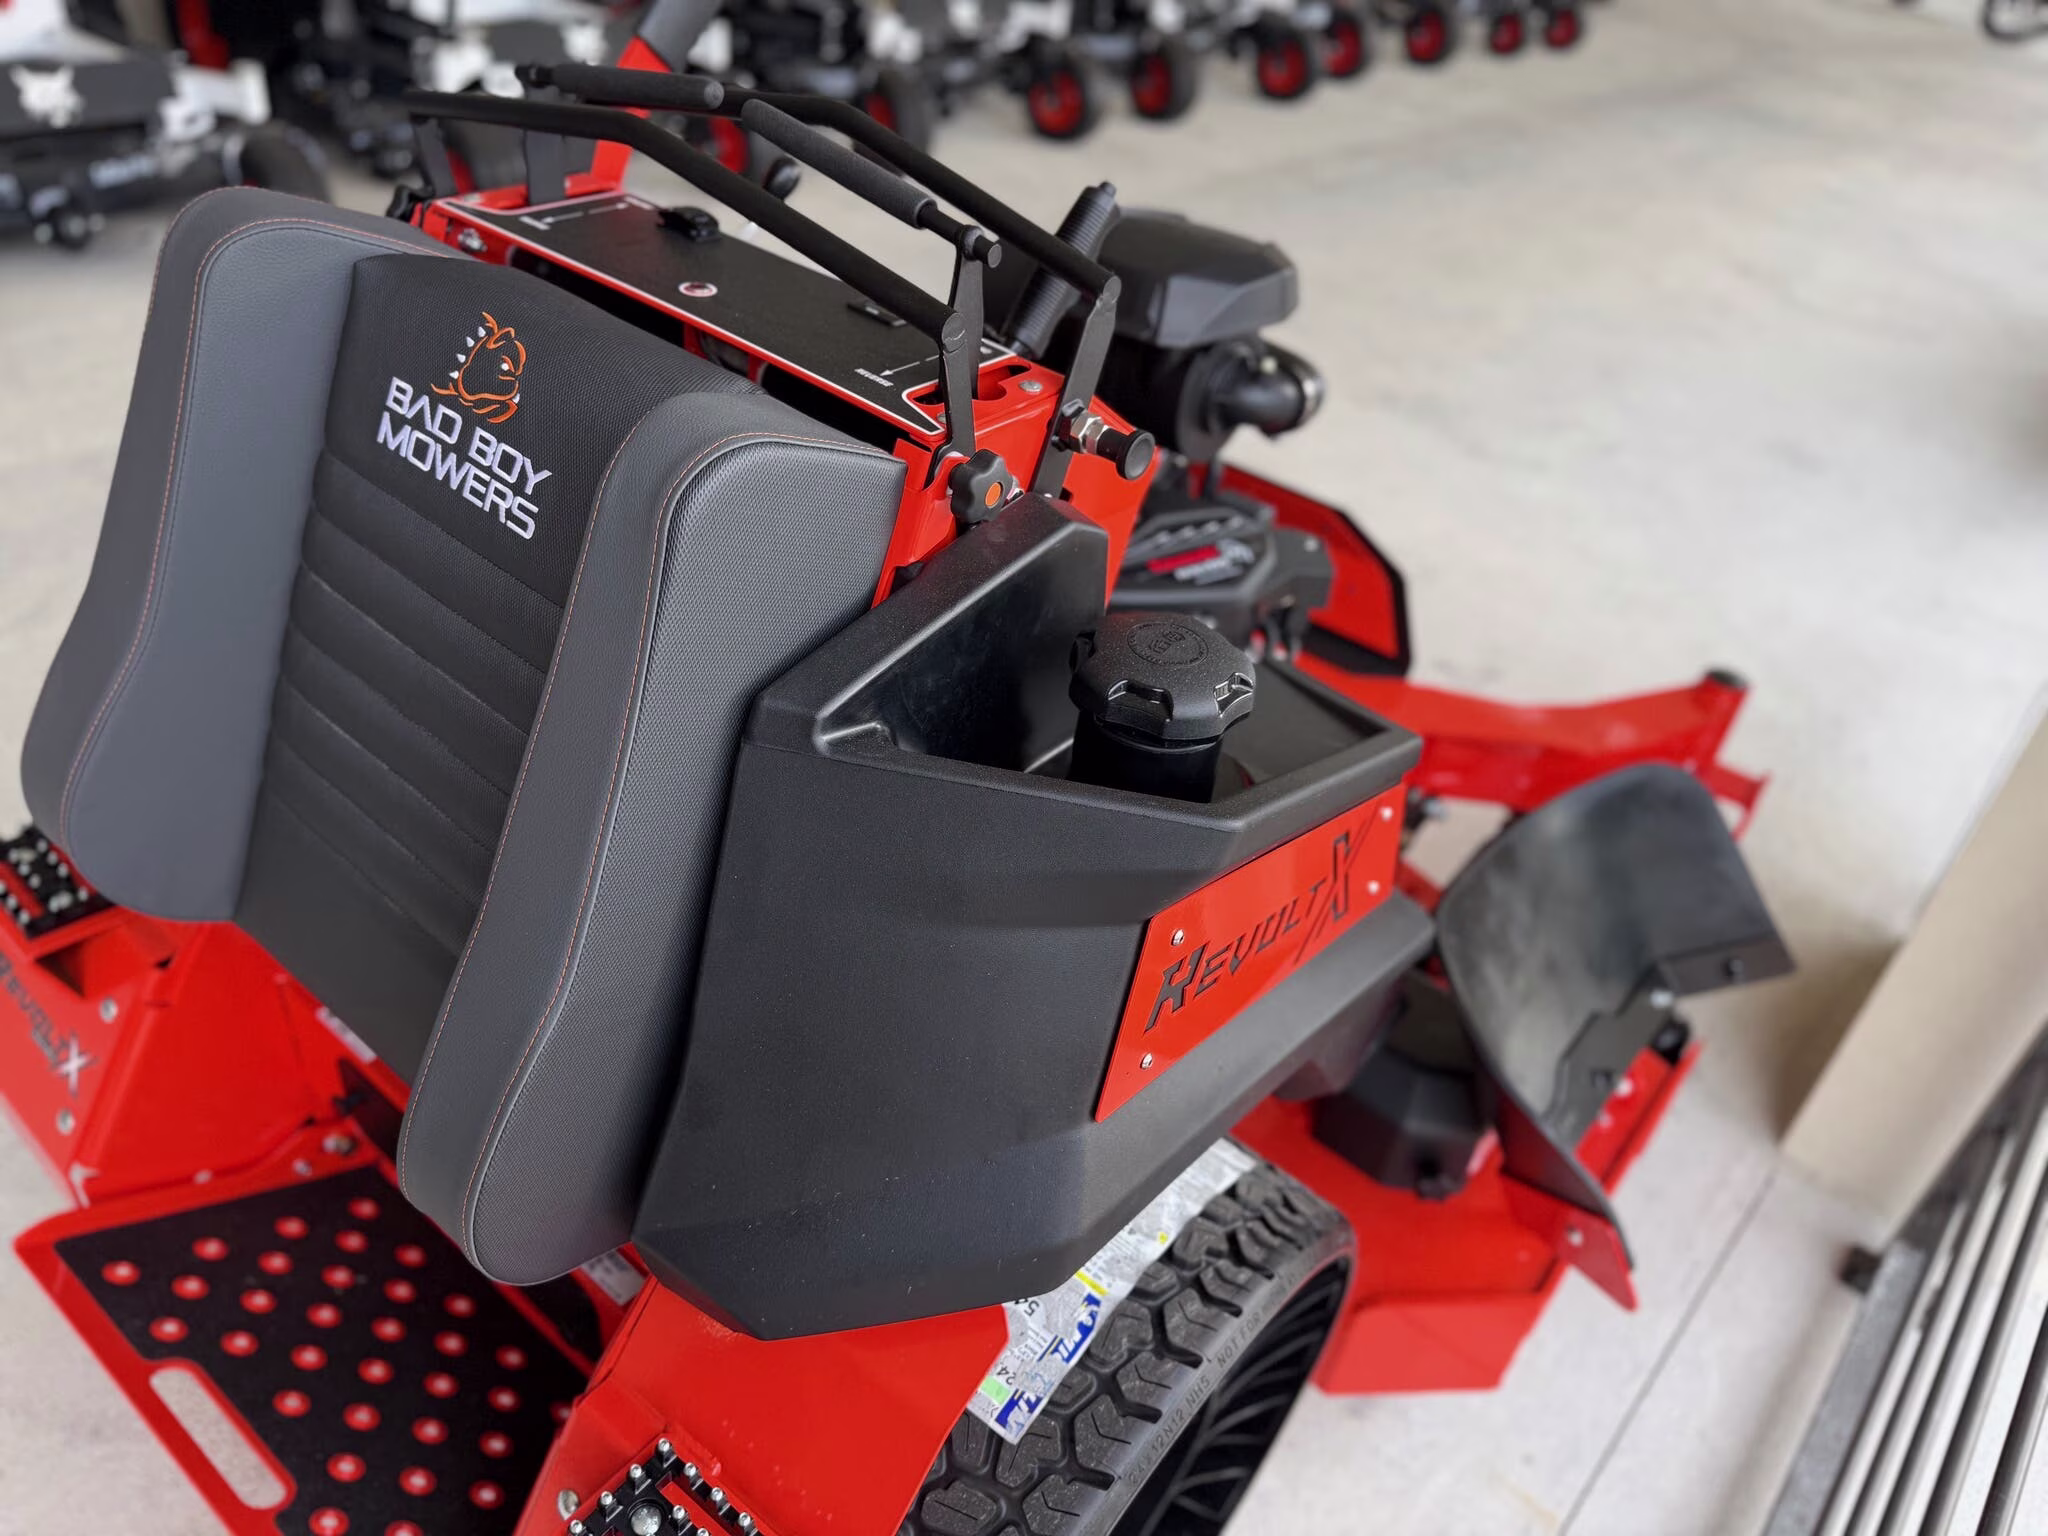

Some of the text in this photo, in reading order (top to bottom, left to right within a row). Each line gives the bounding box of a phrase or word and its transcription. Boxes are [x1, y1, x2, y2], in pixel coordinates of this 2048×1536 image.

[376, 411, 539, 539] MOWERS
[385, 376, 553, 495] BAD BOY
